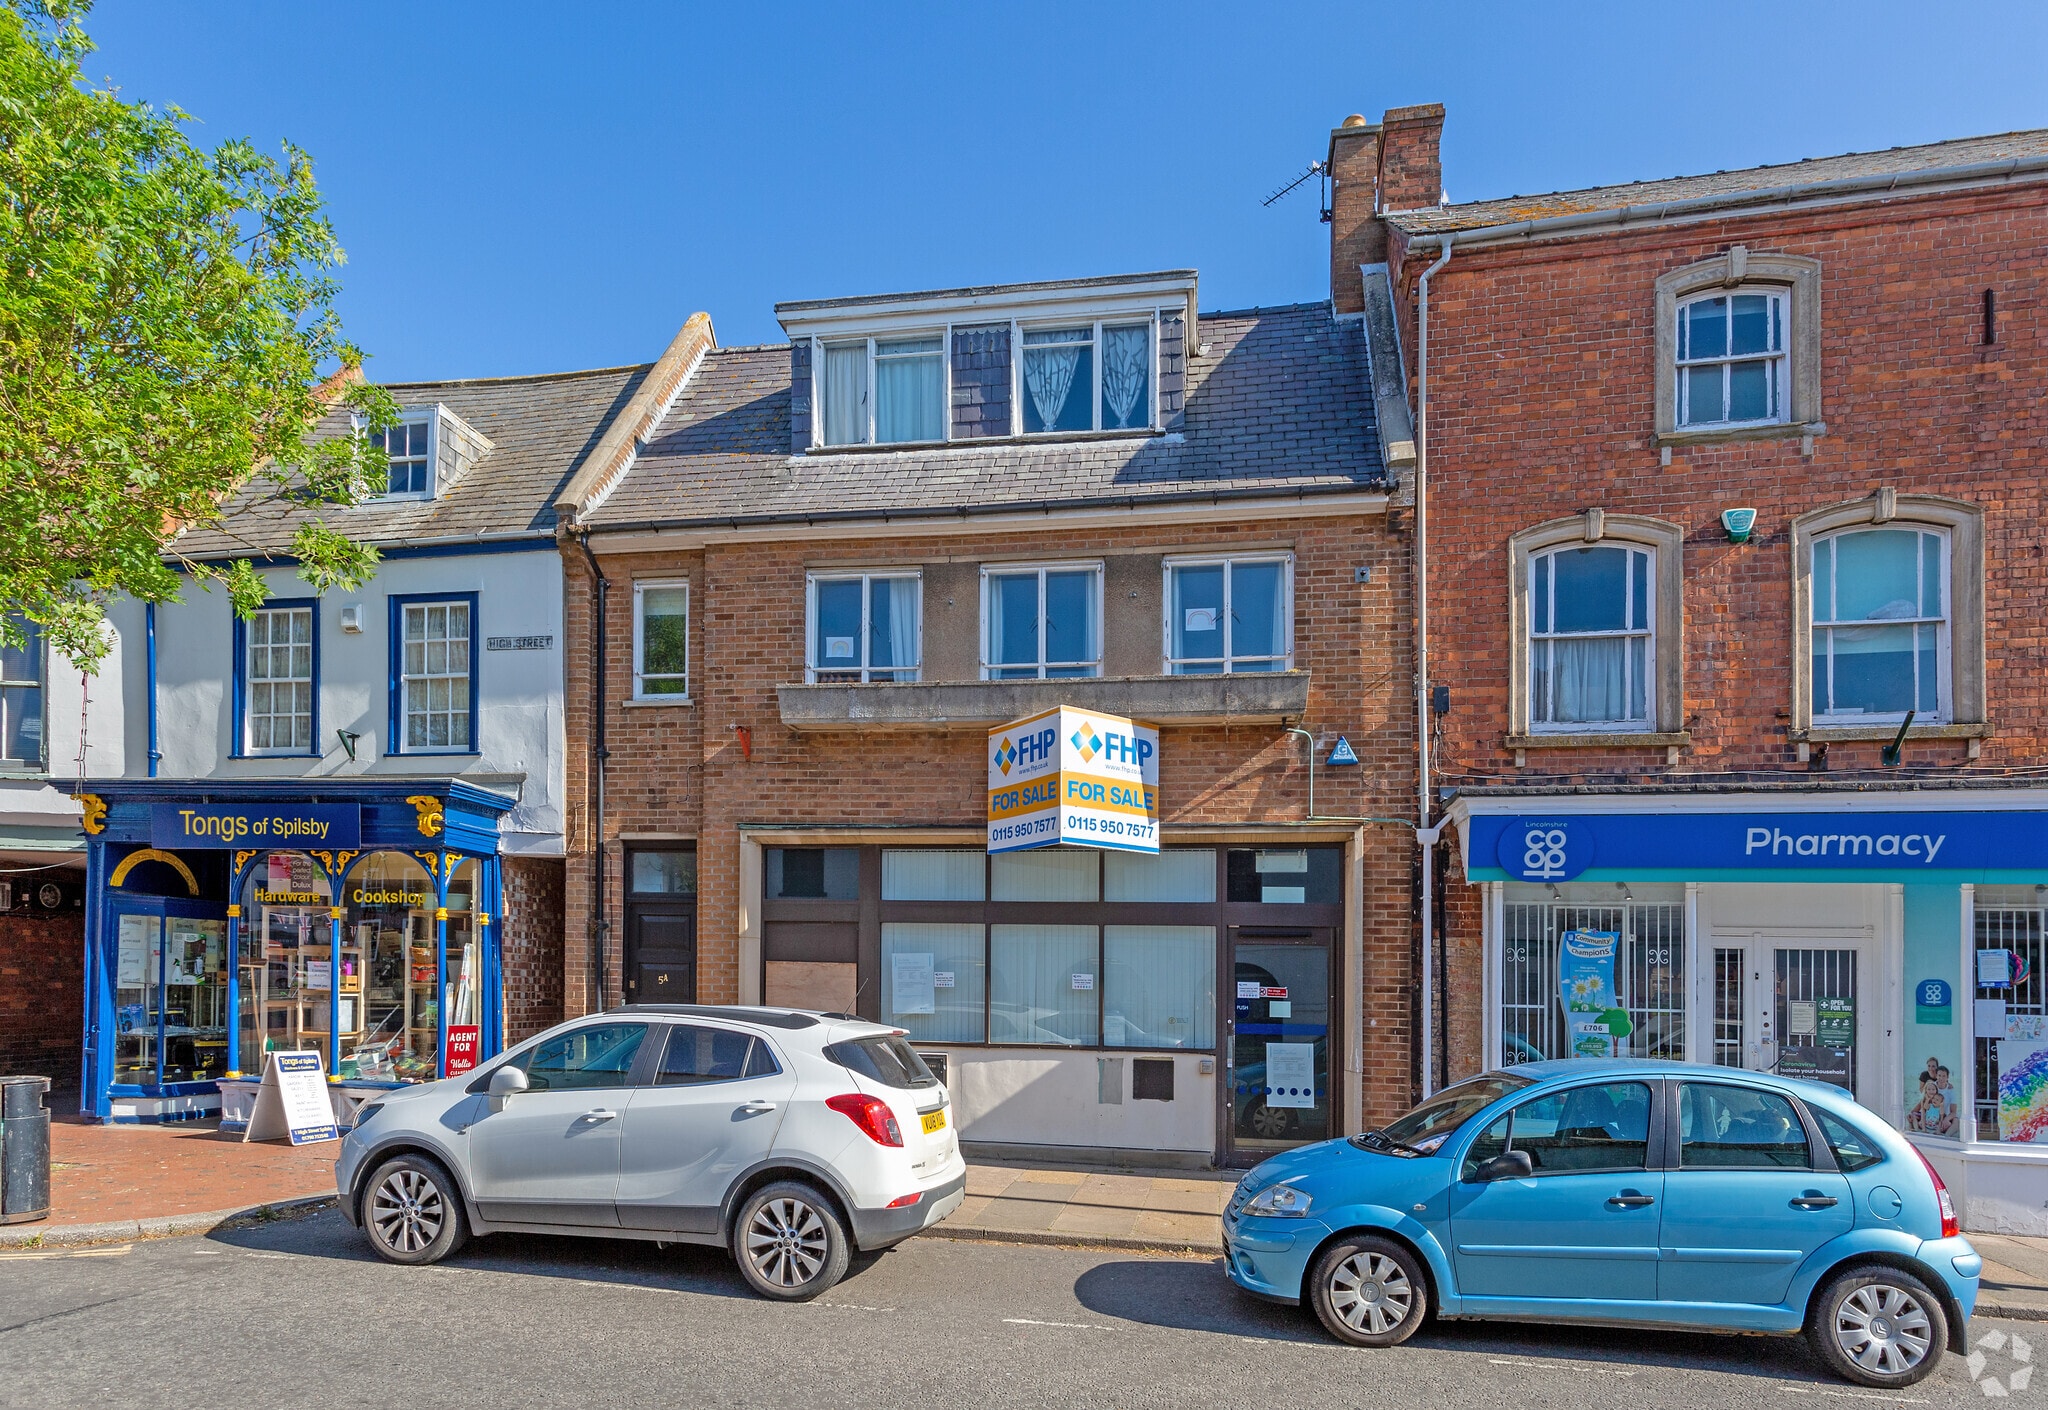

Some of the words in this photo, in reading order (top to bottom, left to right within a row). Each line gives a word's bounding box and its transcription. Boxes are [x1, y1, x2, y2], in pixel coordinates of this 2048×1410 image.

[489, 638, 512, 649] HIGH
[515, 638, 552, 648] STREET
[1018, 728, 1056, 766] FHP
[1105, 731, 1153, 767] FHP
[1018, 761, 1049, 775] www.fhp.co.uk
[1105, 763, 1144, 776] www.fhp.co.uk
[992, 790, 1019, 812] FOR
[1022, 780, 1057, 809] SALE
[1068, 780, 1105, 803] FOR
[1110, 787, 1154, 811] SALE
[179, 810, 249, 842] Tongs
[252, 817, 269, 835] of
[272, 817, 330, 840] Spilsby
[992, 827, 1013, 841] 0115
[1014, 824, 1033, 838] 950
[1034, 816, 1057, 834] 7577
[1068, 815, 1097, 831] 0115
[1100, 819, 1124, 835] 950
[1126, 823, 1154, 839] 7577
[1745, 827, 1946, 863] Pharmacy
[292, 881, 312, 889] Dulux
[254, 888, 321, 903] Hardware
[353, 889, 427, 906] Cookshop
[1575, 934, 1611, 945] Community
[1583, 1024, 1603, 1032] £706
[449, 1032, 477, 1042] AGENT
[454, 1042, 470, 1052] FOR
[1780, 1060, 1817, 1068] Coronavirus
